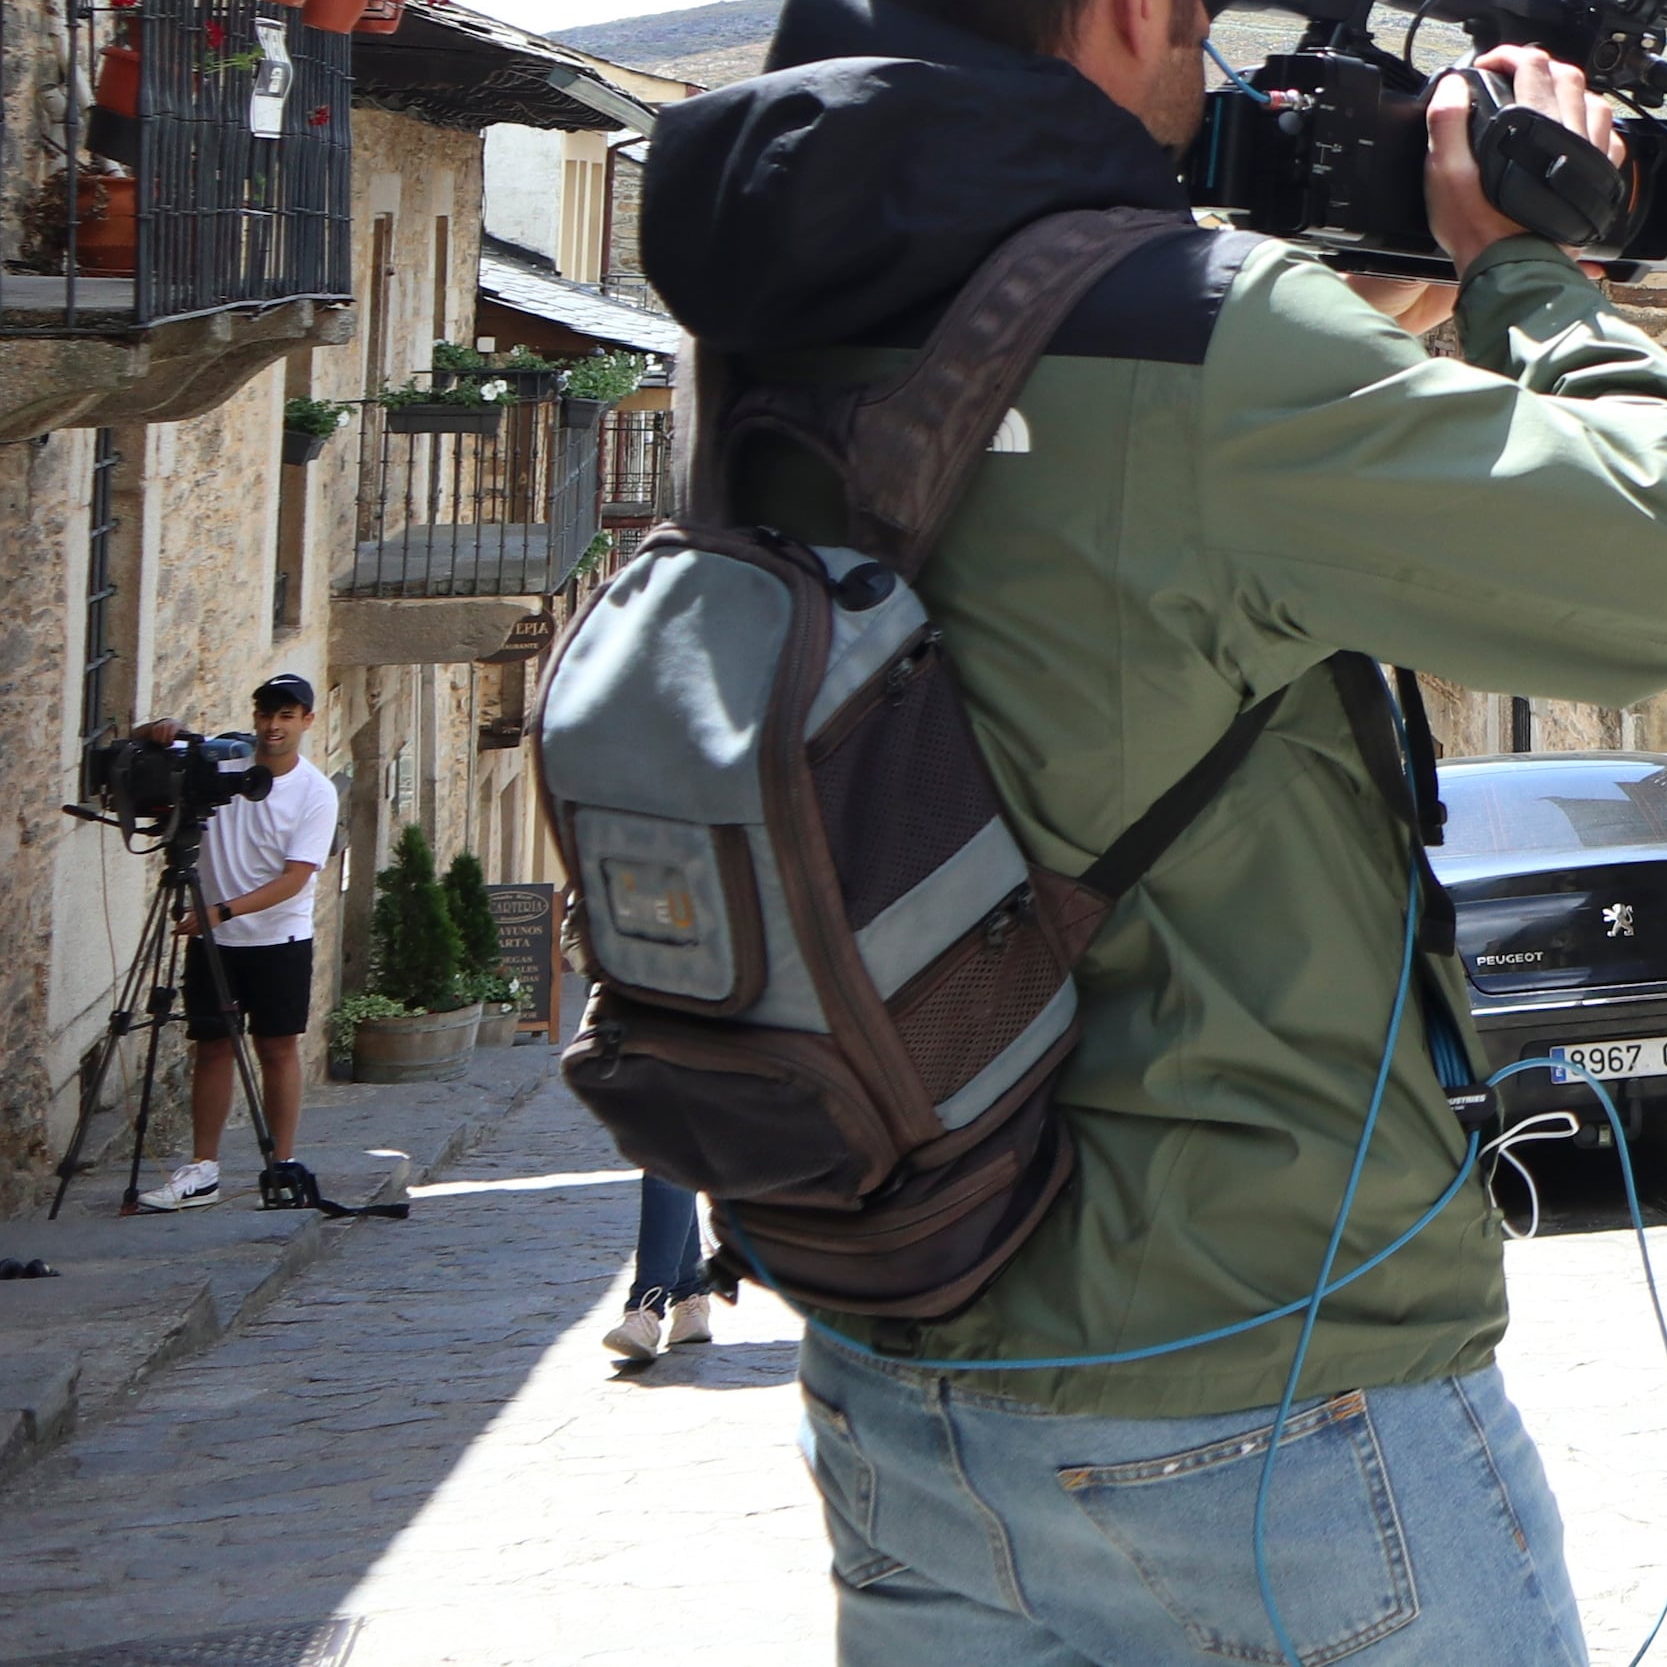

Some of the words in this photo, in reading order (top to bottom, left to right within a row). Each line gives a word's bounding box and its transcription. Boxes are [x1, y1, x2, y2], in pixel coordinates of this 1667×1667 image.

[515, 621, 549, 636] ERIA
[498, 925, 543, 936] AYUNOS
[498, 938, 531, 948] ARTA
[1476, 950, 1545, 967] PEUGEOT
[1569, 1043, 1643, 1076] 8967
[1448, 1094, 1487, 1106] USTRIES
